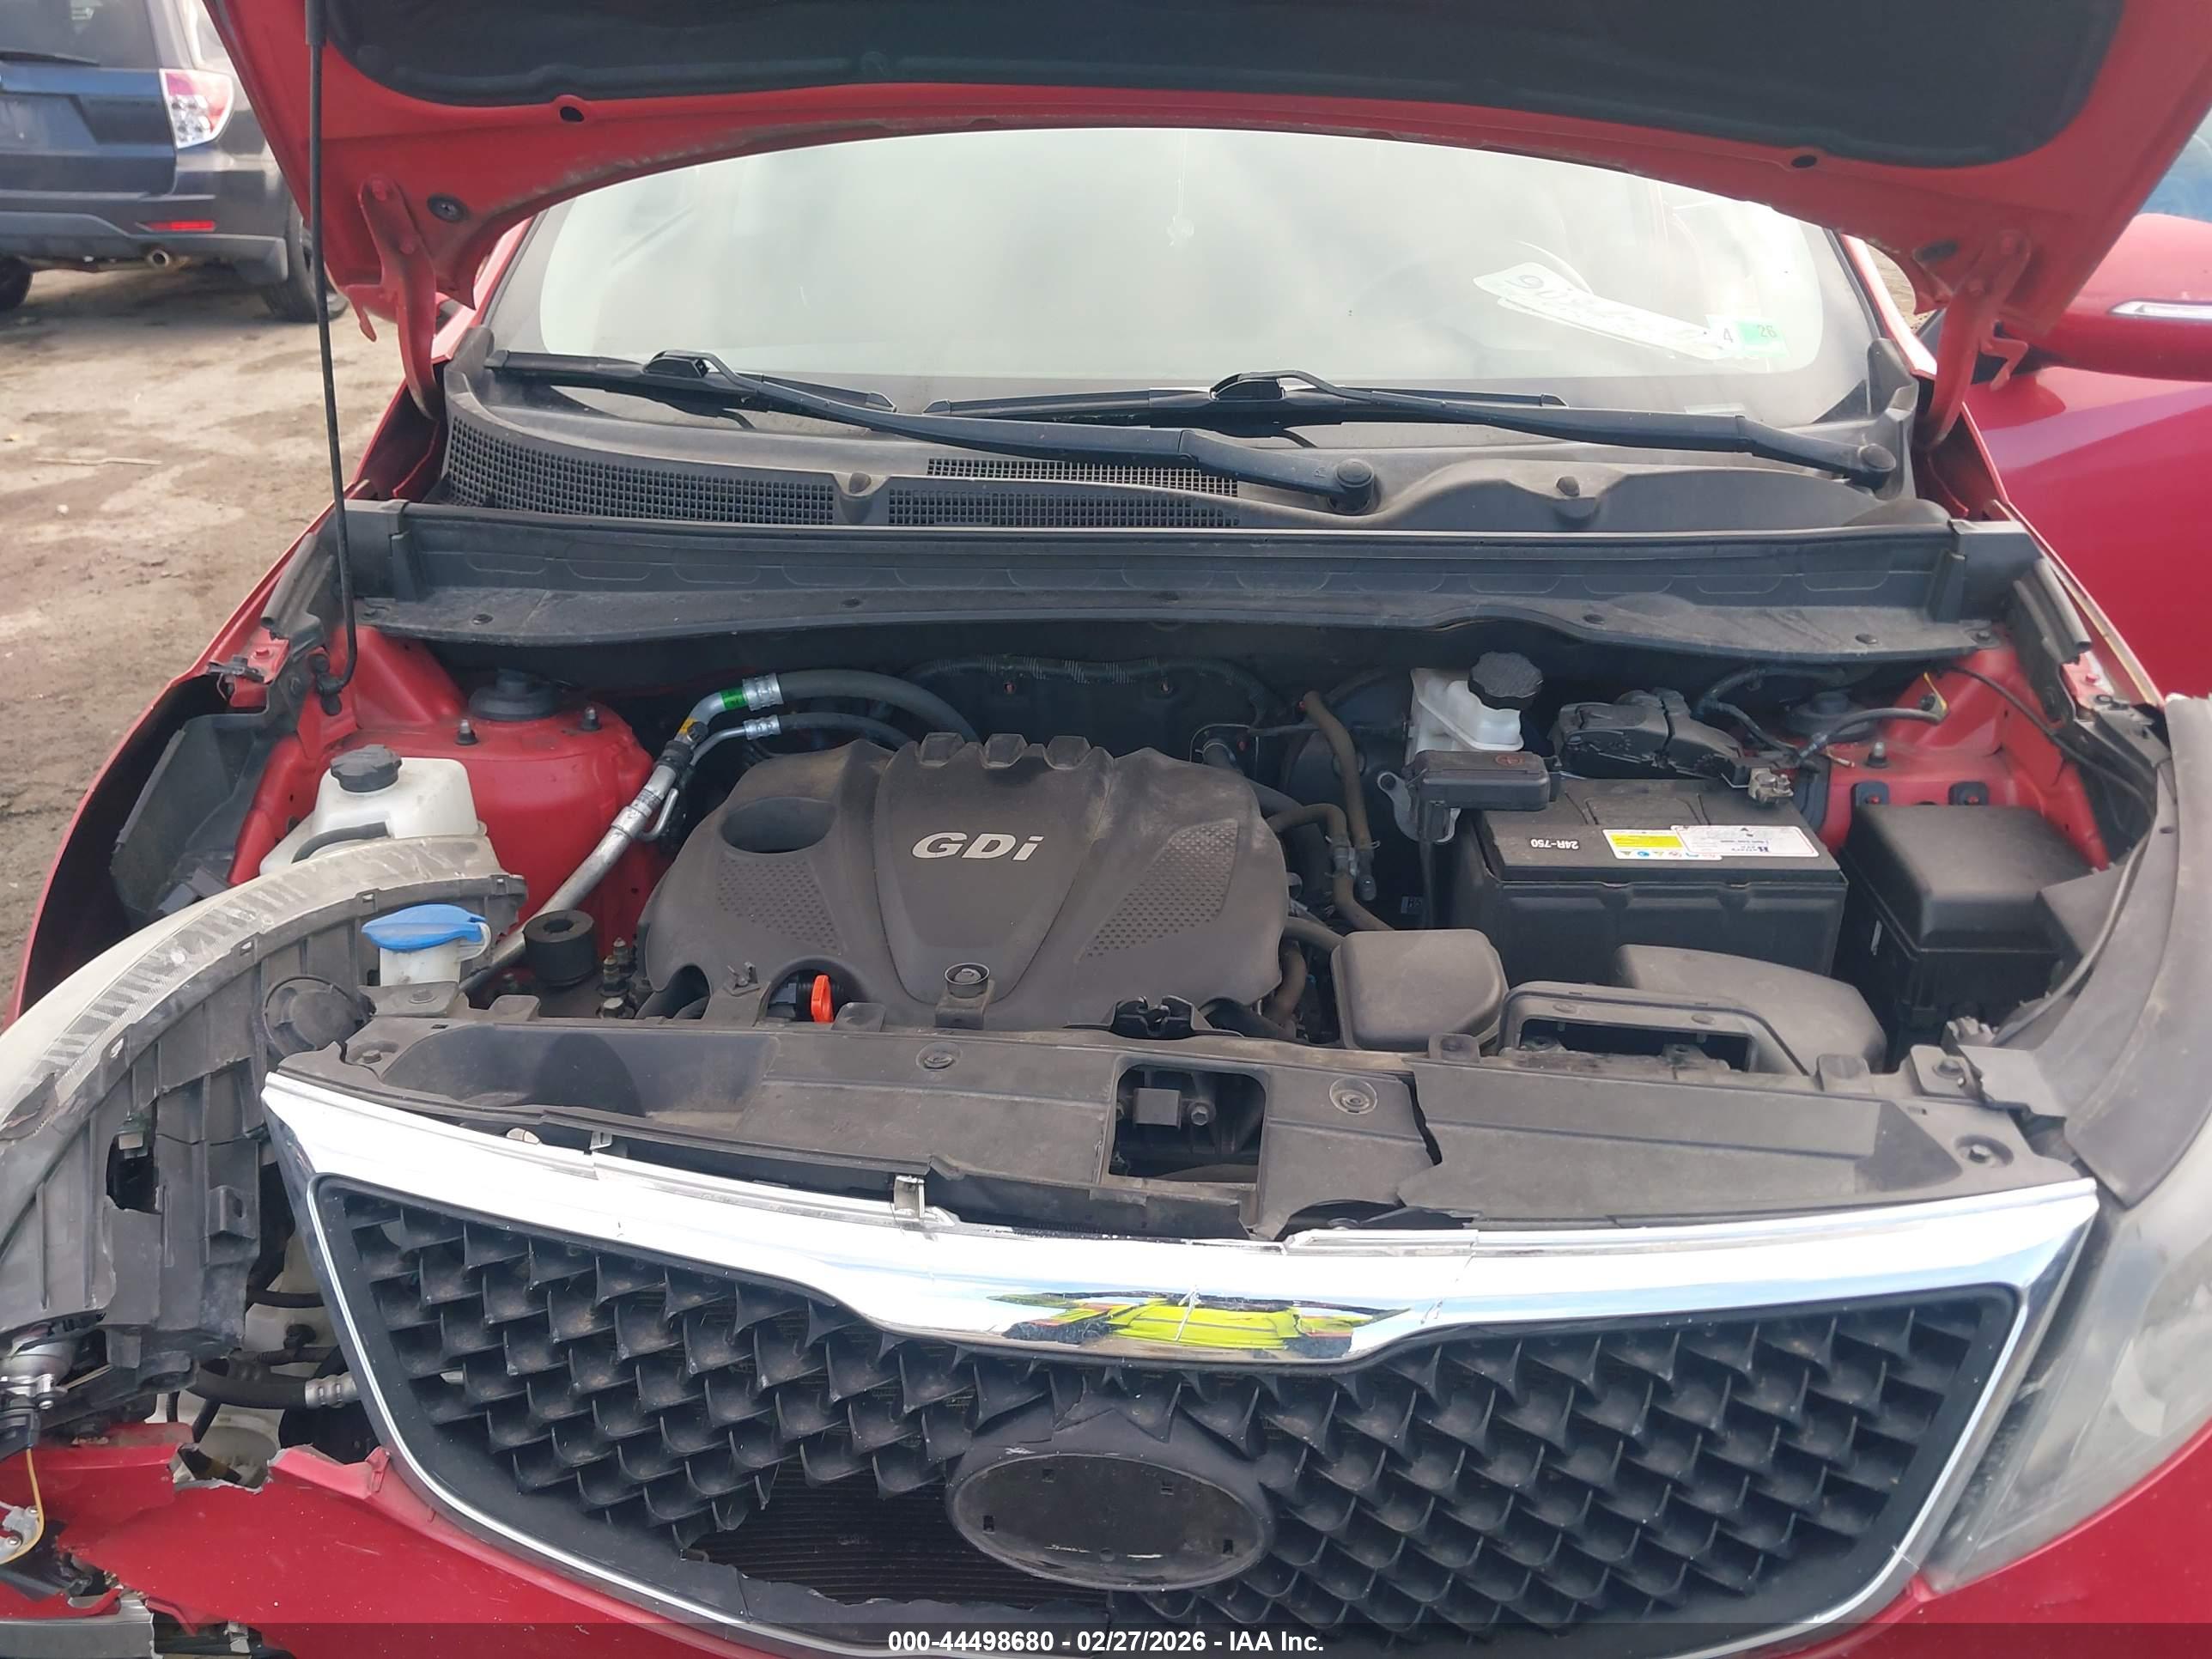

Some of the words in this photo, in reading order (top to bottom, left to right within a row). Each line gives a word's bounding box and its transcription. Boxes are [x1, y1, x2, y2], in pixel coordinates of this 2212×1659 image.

[1723, 327, 1734, 343] 4
[1757, 325, 1778, 338] 26
[912, 831, 1044, 861] GDi
[1530, 838, 1579, 850] 24R-750
